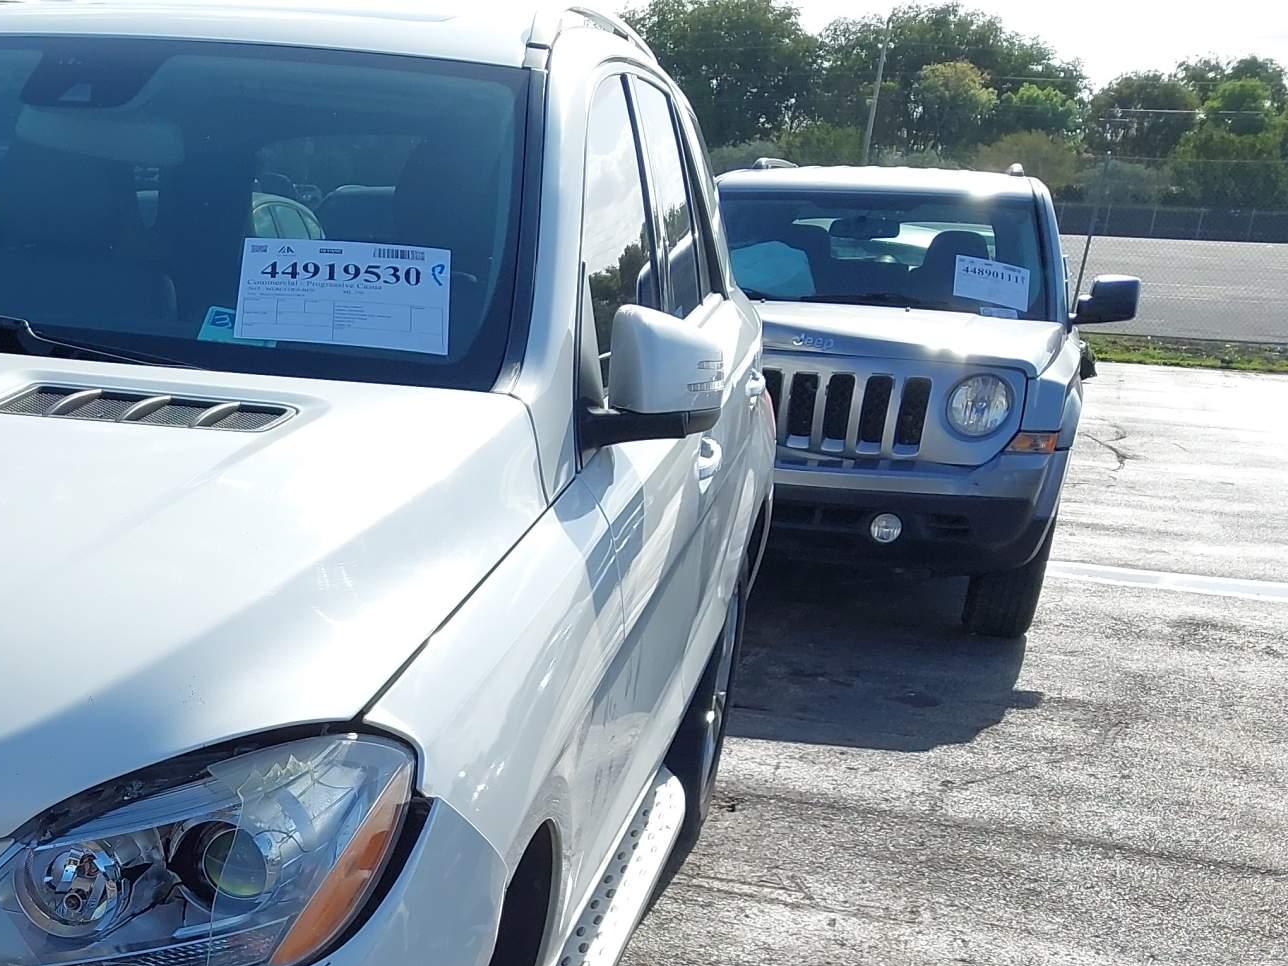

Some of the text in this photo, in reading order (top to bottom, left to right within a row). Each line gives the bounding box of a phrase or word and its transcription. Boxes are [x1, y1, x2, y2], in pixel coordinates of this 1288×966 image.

[261, 260, 421, 287] 44919530
[247, 279, 298, 287] Commercial
[306, 280, 353, 291] Progressive
[792, 333, 834, 351] Jeep
